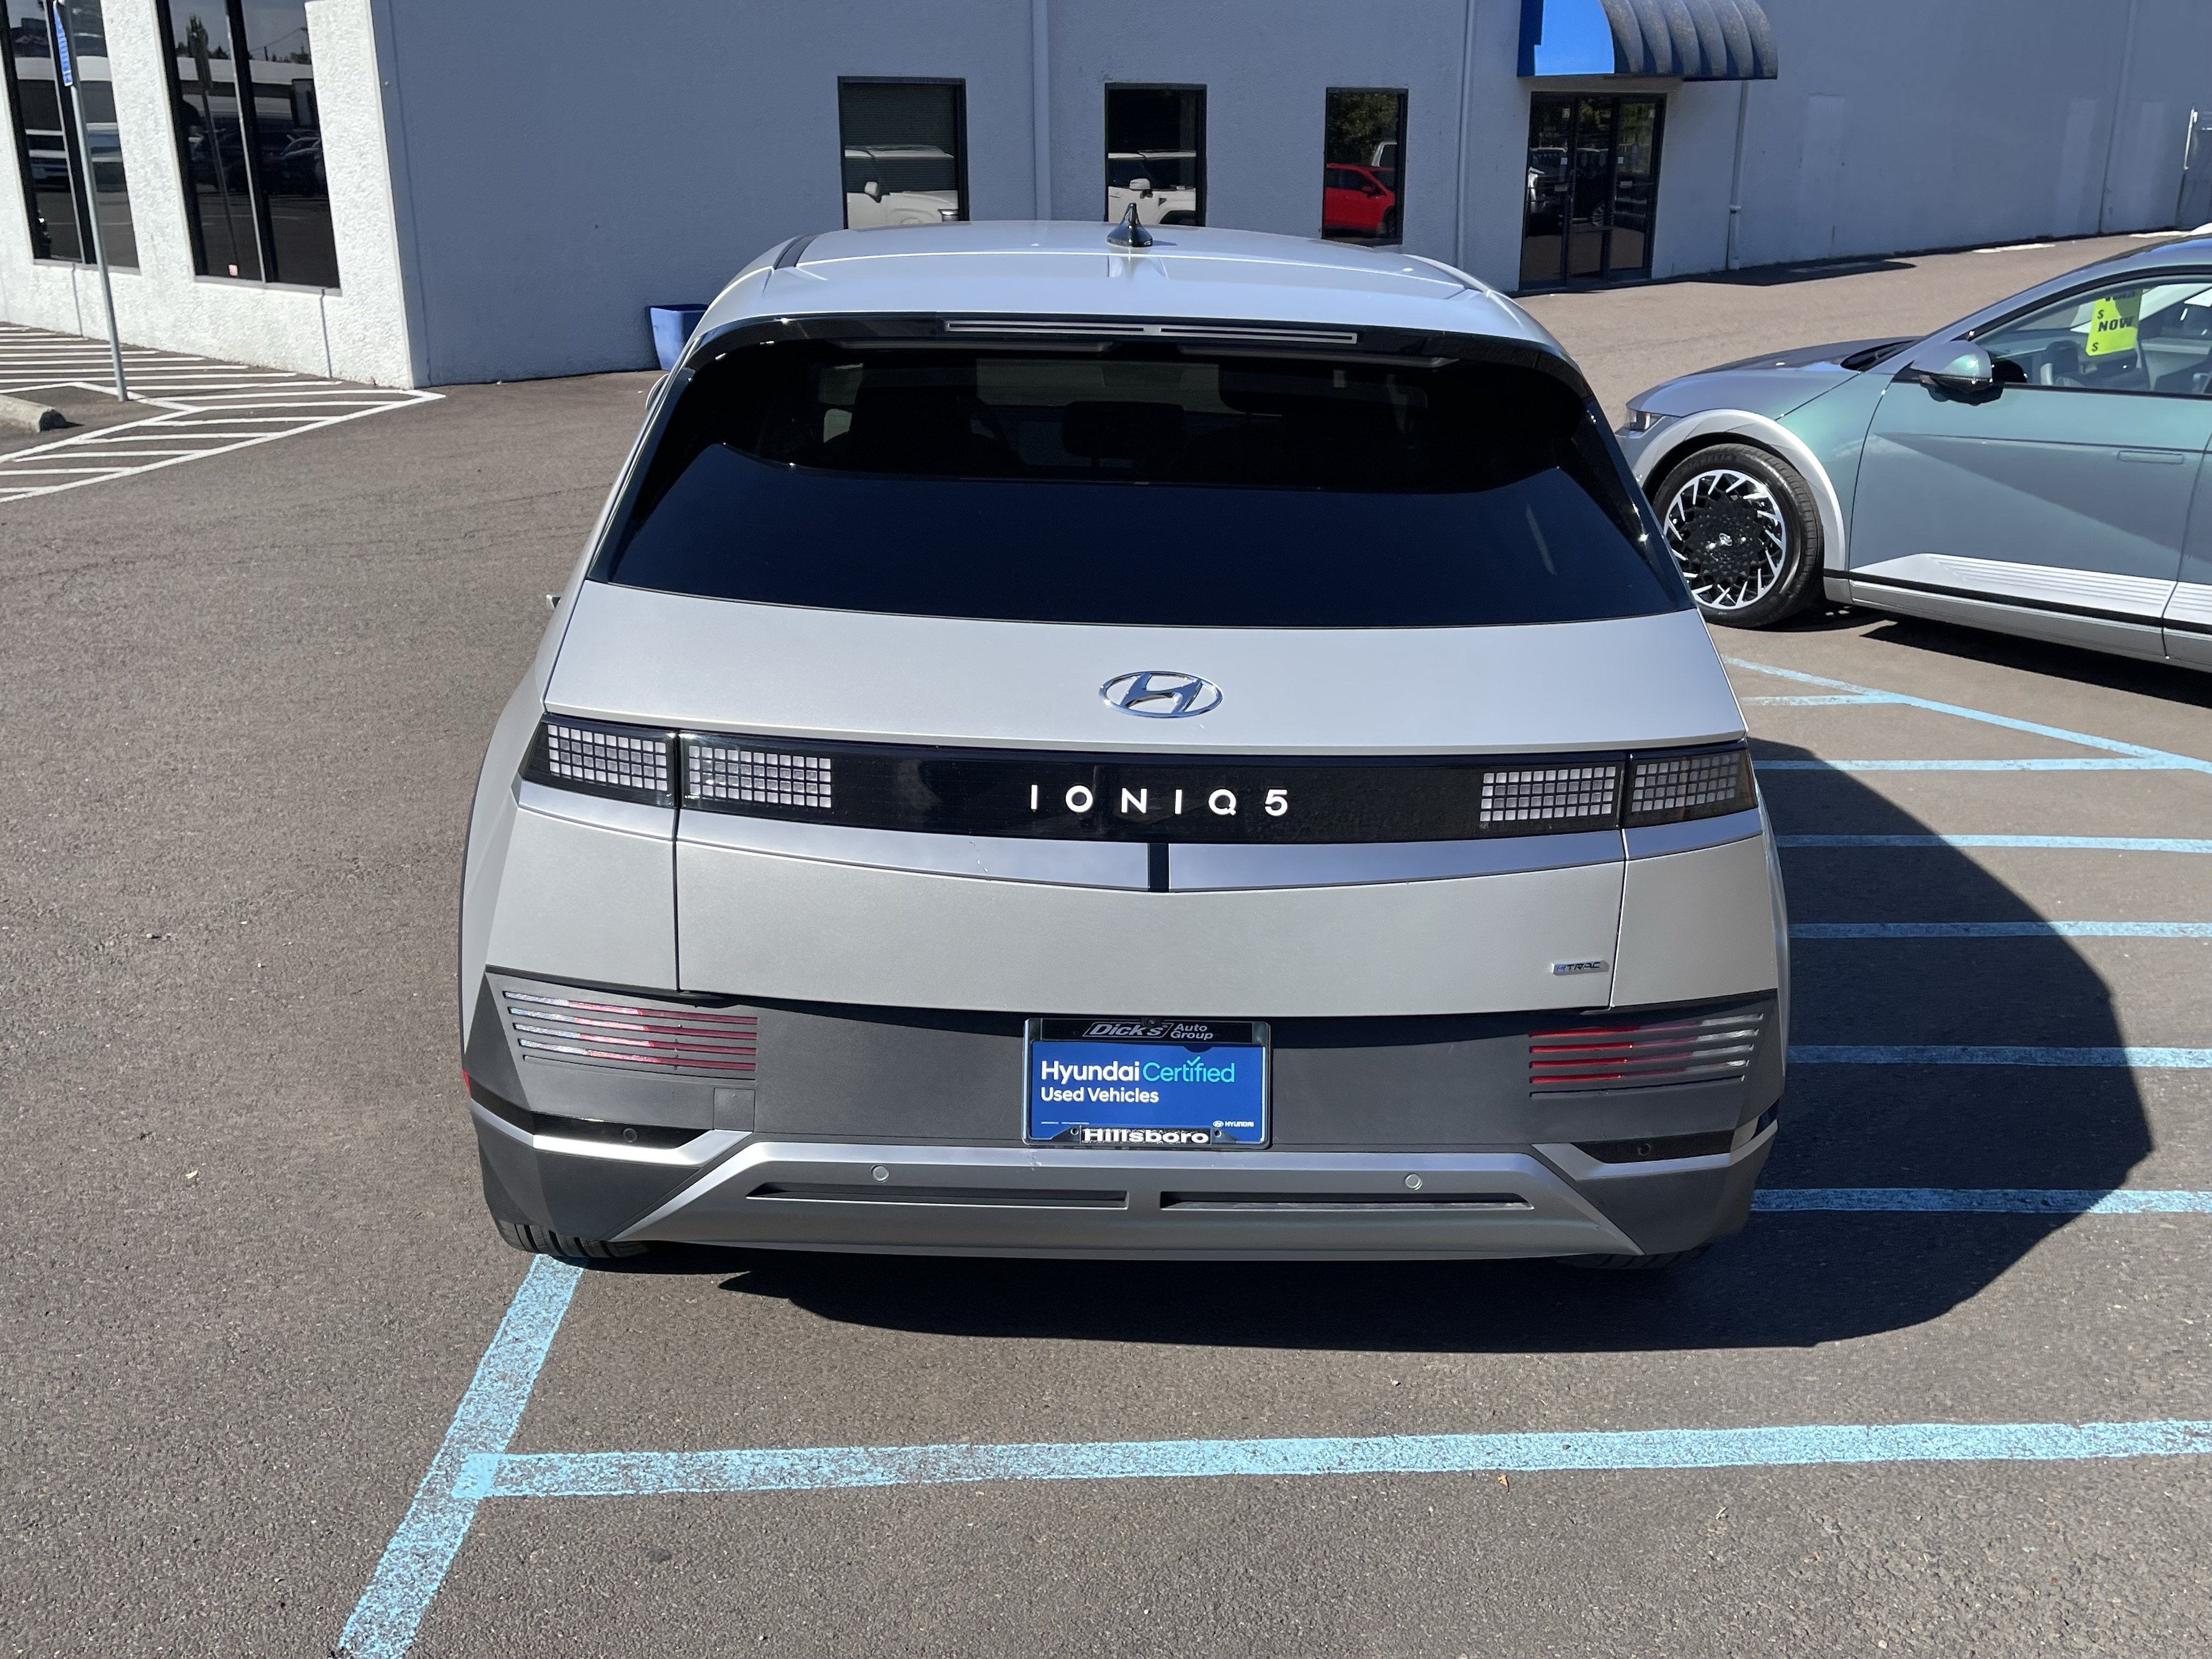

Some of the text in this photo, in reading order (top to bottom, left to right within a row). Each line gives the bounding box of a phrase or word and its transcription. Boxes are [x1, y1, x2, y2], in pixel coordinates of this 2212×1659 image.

[2098, 317, 2132, 331] NOW
[1030, 785, 1288, 816] IONIQ 5
[1556, 962, 1600, 972] HTRAC
[1089, 1024, 1164, 1036] Dicks
[1173, 1023, 1208, 1031] Auto
[1170, 1031, 1214, 1040] Group
[1041, 1056, 1235, 1085] Hyundai Certified
[1041, 1087, 1159, 1103] Used Vehicles
[1083, 1128, 1209, 1143] Hillsboro
